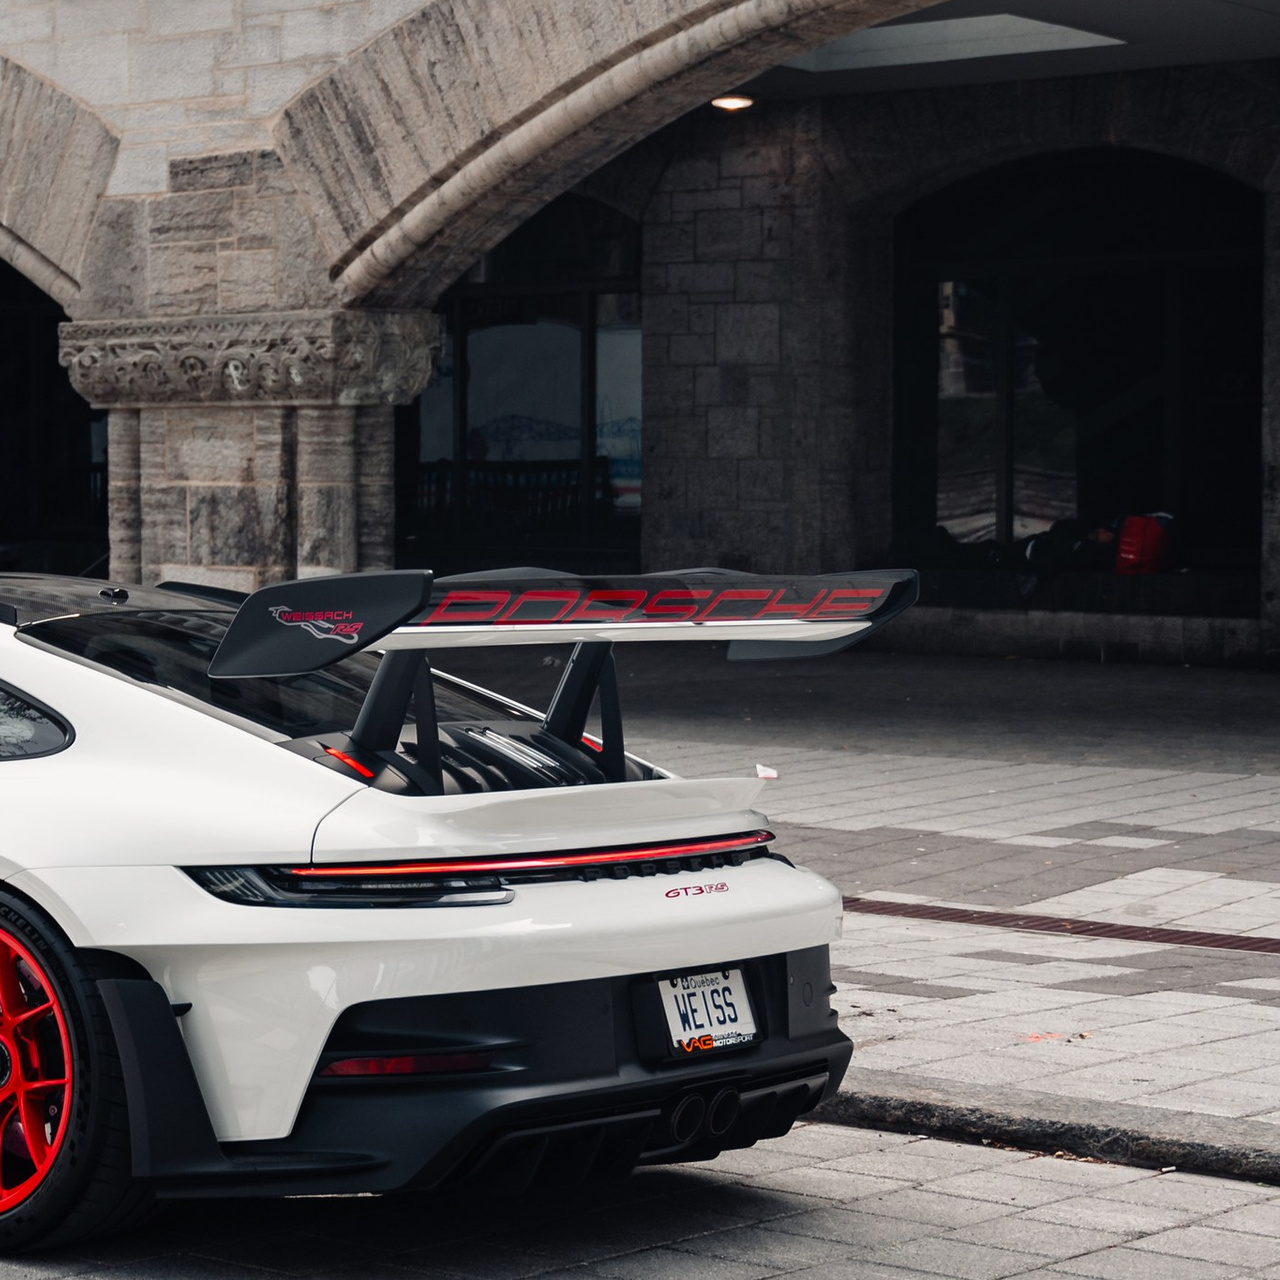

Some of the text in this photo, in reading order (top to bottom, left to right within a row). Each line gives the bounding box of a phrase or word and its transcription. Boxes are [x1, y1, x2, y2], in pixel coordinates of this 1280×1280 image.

[280, 611, 353, 622] WEISSACH
[417, 589, 885, 626] PORSCHE
[689, 975, 720, 989] Québec
[674, 986, 738, 1032] WEISS
[679, 1034, 713, 1053] VAG
[713, 1033, 754, 1047] MOTORSPORT
